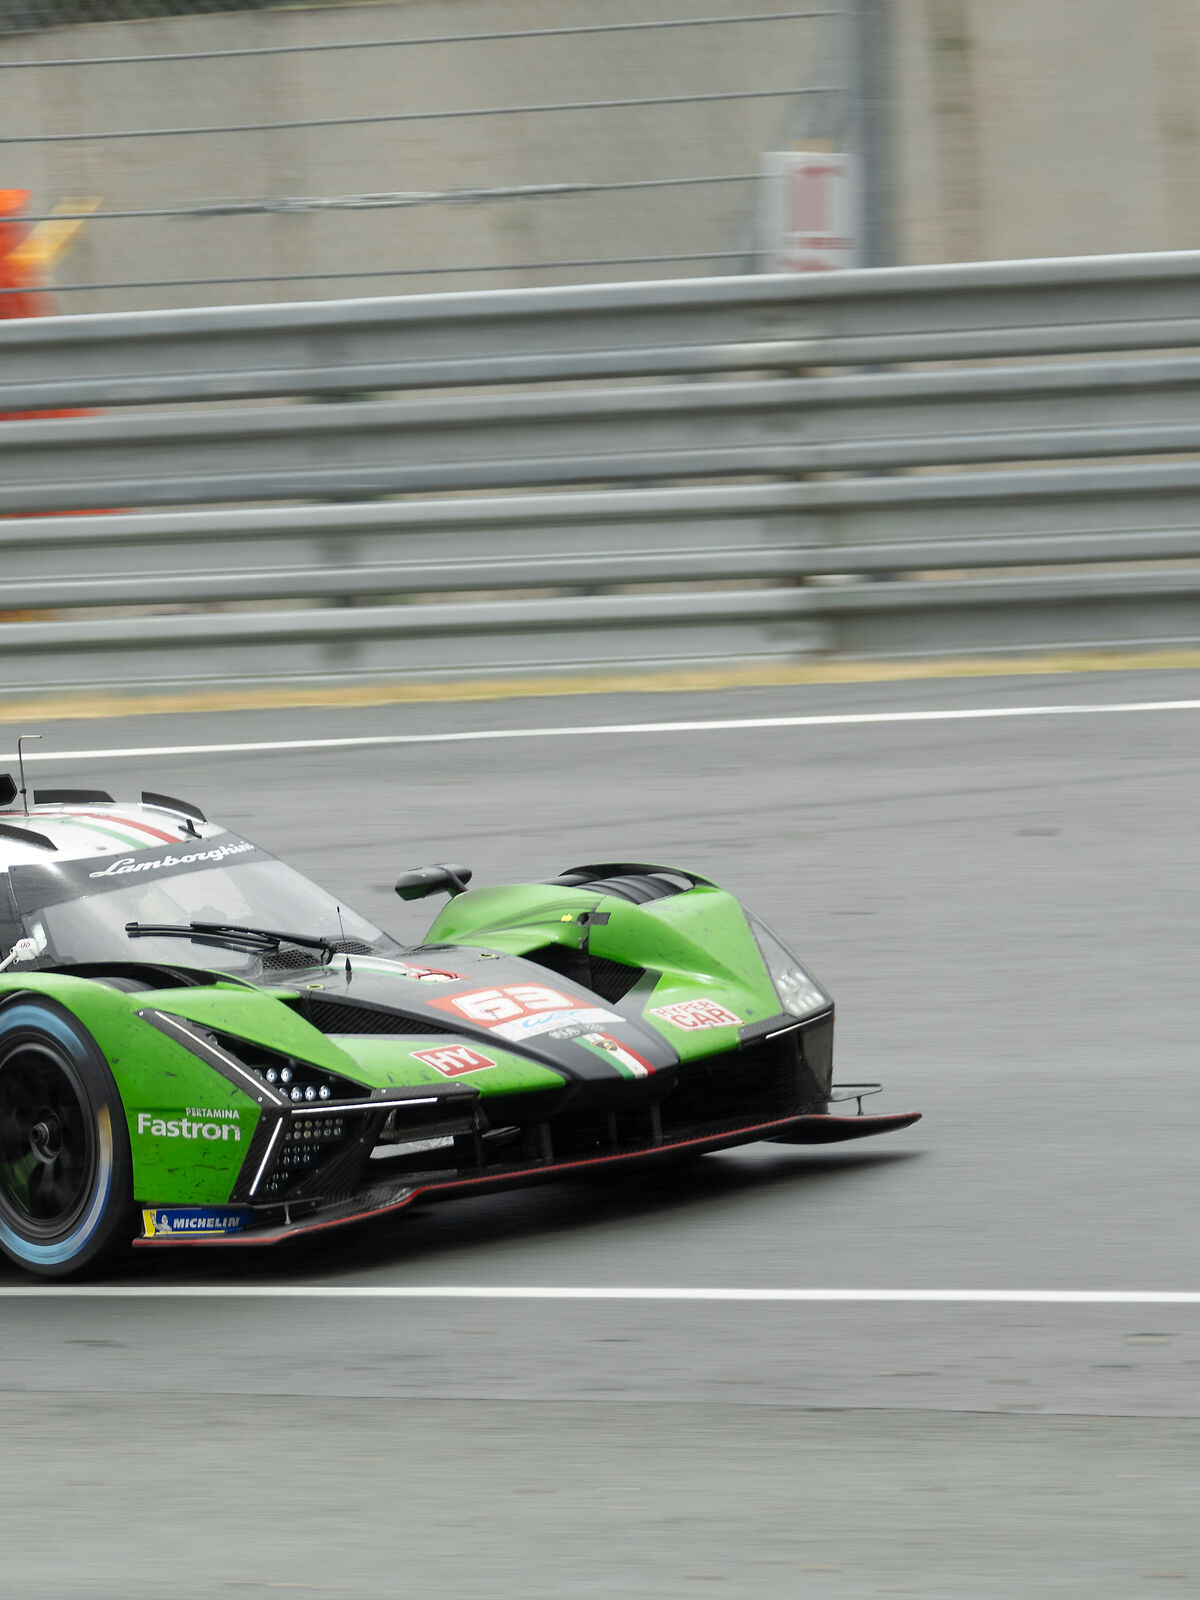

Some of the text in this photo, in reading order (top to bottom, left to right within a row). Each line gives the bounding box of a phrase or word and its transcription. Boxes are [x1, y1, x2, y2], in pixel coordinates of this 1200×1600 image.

[88, 841, 255, 878] Lamborghini
[451, 985, 575, 1021] 63
[671, 1008, 737, 1028] CAR
[421, 1047, 479, 1073] HY
[185, 1107, 240, 1119] PERTAMINA
[137, 1112, 241, 1141] Fastron
[173, 1216, 240, 1229] MICHELIN
